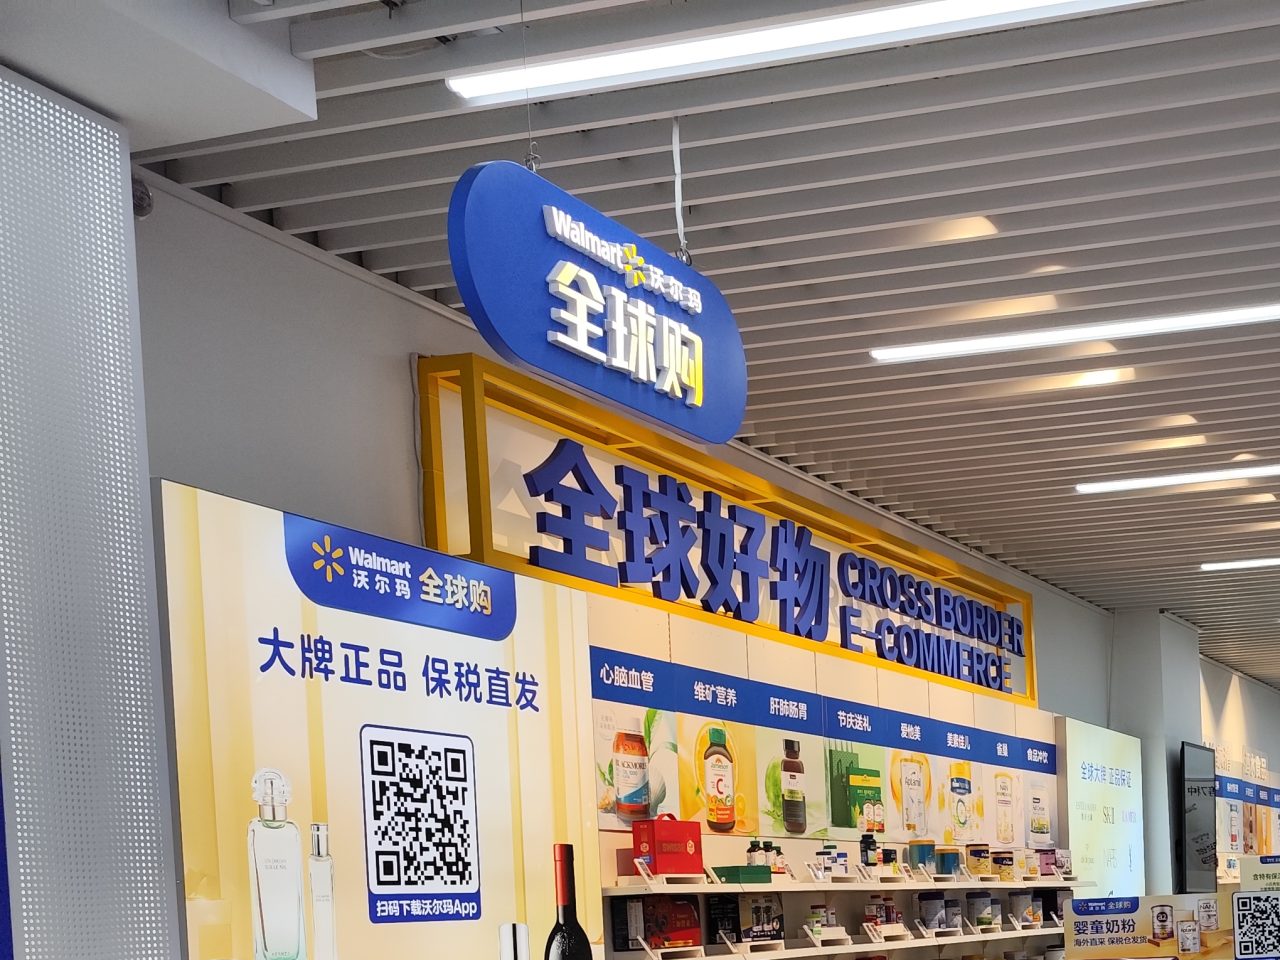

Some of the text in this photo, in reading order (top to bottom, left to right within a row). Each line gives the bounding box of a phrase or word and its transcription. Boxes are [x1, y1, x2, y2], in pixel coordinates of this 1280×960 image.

[543, 205, 624, 273] Walmart
[642, 264, 702, 315] 沃尔玛
[546, 259, 703, 409] 全球购
[523, 438, 831, 644] 全球好物
[347, 545, 411, 579] Walmart
[352, 568, 411, 600] 沃尔玛
[418, 567, 493, 616] 全球购
[837, 552, 1026, 658] CROSS BORDER
[839, 605, 1014, 695] E-COMMERCE
[257, 626, 541, 713] 大牌正品 保税直发
[600, 663, 655, 692] 心脑血管
[693, 680, 737, 707] 维矿营养
[769, 697, 808, 721] 肝肺肠胃
[837, 710, 872, 732] 节庆送礼
[900, 722, 921, 742] 爱他美
[1081, 761, 1132, 788] 全球大牌 正品保证
[375, 899, 478, 919] 扫码下载沃尔玛App
[1108, 901, 1132, 910] 全球购
[1073, 918, 1137, 936] 婴童奶粉
[1074, 937, 1106, 947] 海外直采
